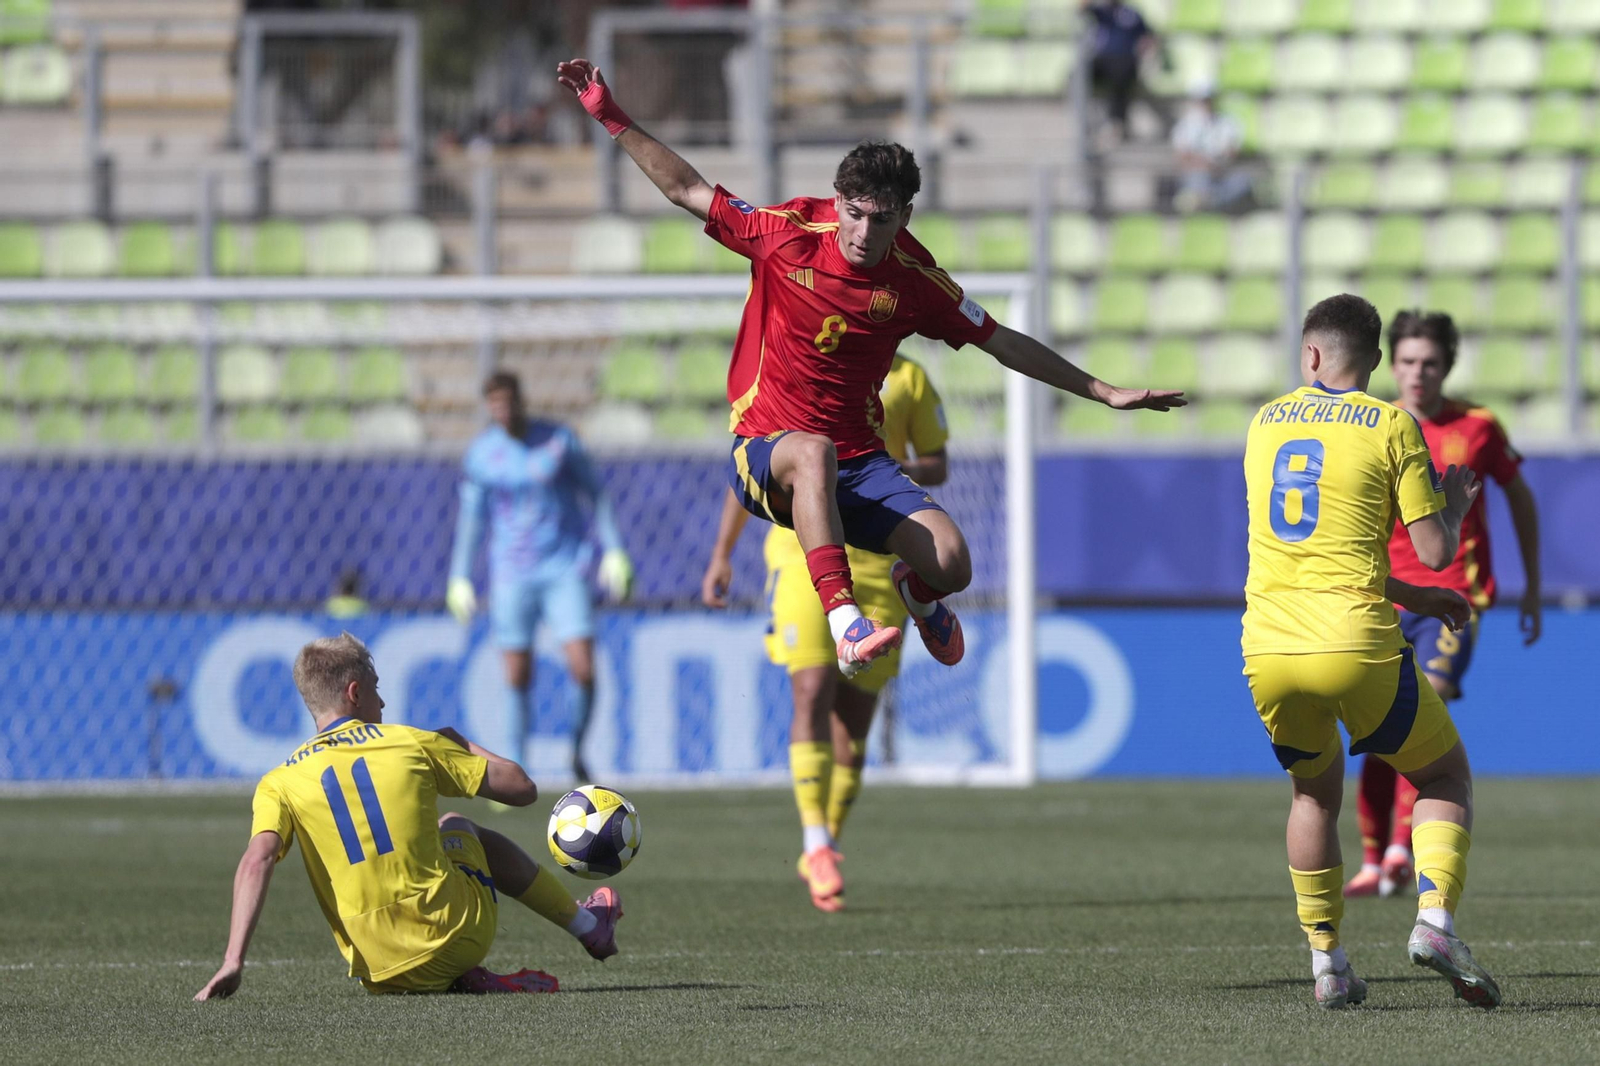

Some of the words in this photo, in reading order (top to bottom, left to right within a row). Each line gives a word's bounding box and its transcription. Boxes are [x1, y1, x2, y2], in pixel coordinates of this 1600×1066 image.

[814, 315, 847, 353] 8
[1260, 401, 1381, 428] VASHCHENKO
[1269, 438, 1325, 542] 8
[320, 756, 394, 865] 11
